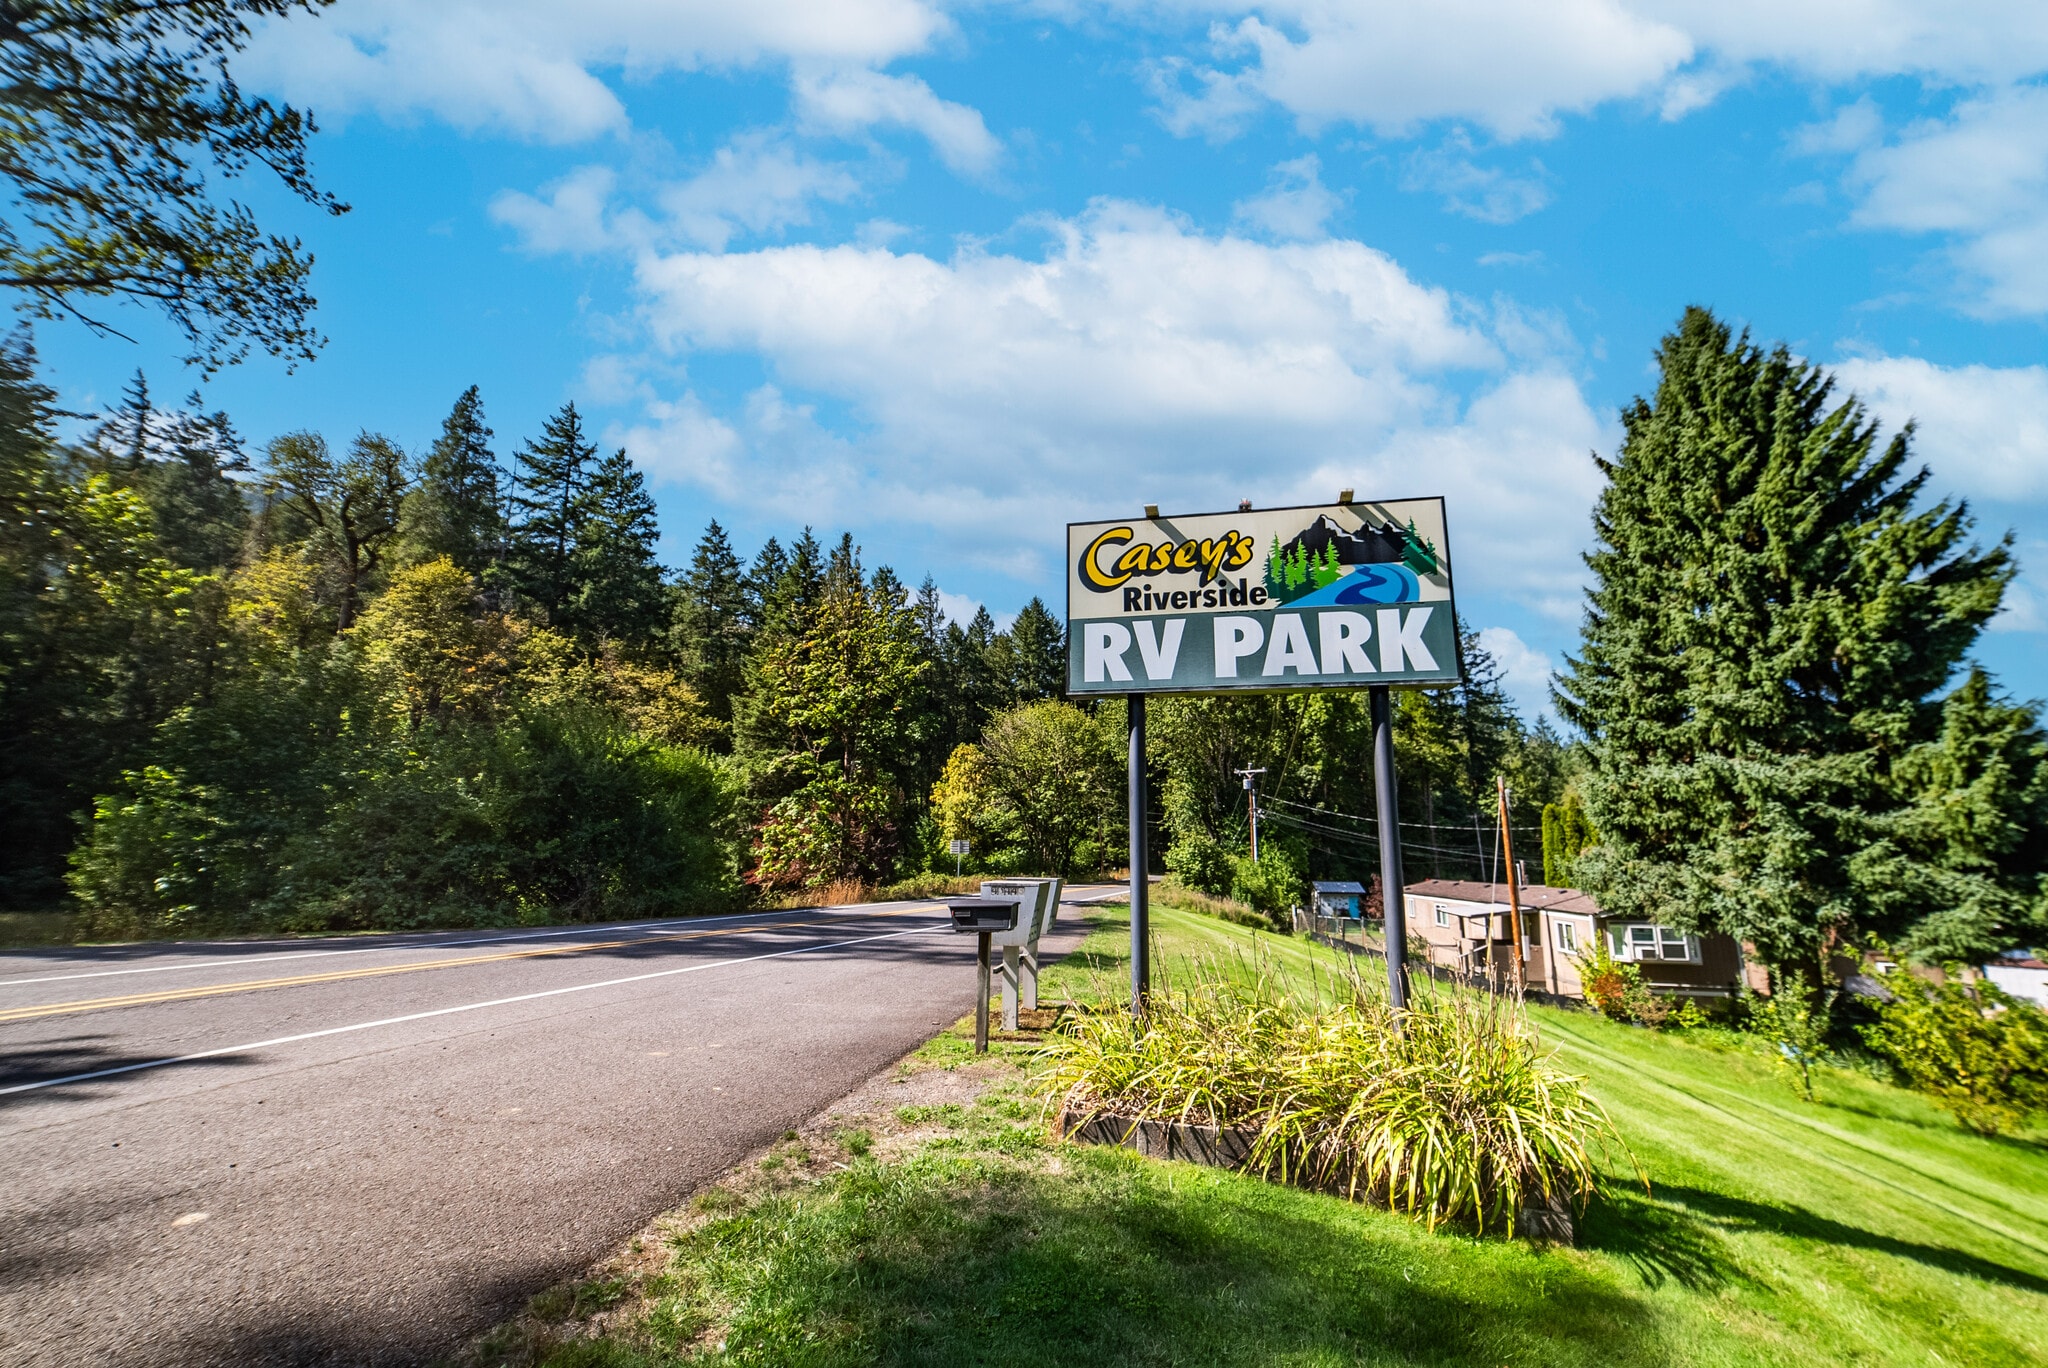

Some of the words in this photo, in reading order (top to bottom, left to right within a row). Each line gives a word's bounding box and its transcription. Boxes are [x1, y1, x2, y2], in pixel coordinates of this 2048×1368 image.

[1078, 526, 1255, 593] Casey's
[1123, 578, 1267, 612] Riverside
[1084, 619, 1187, 682] RV
[1213, 607, 1440, 678] PARK
